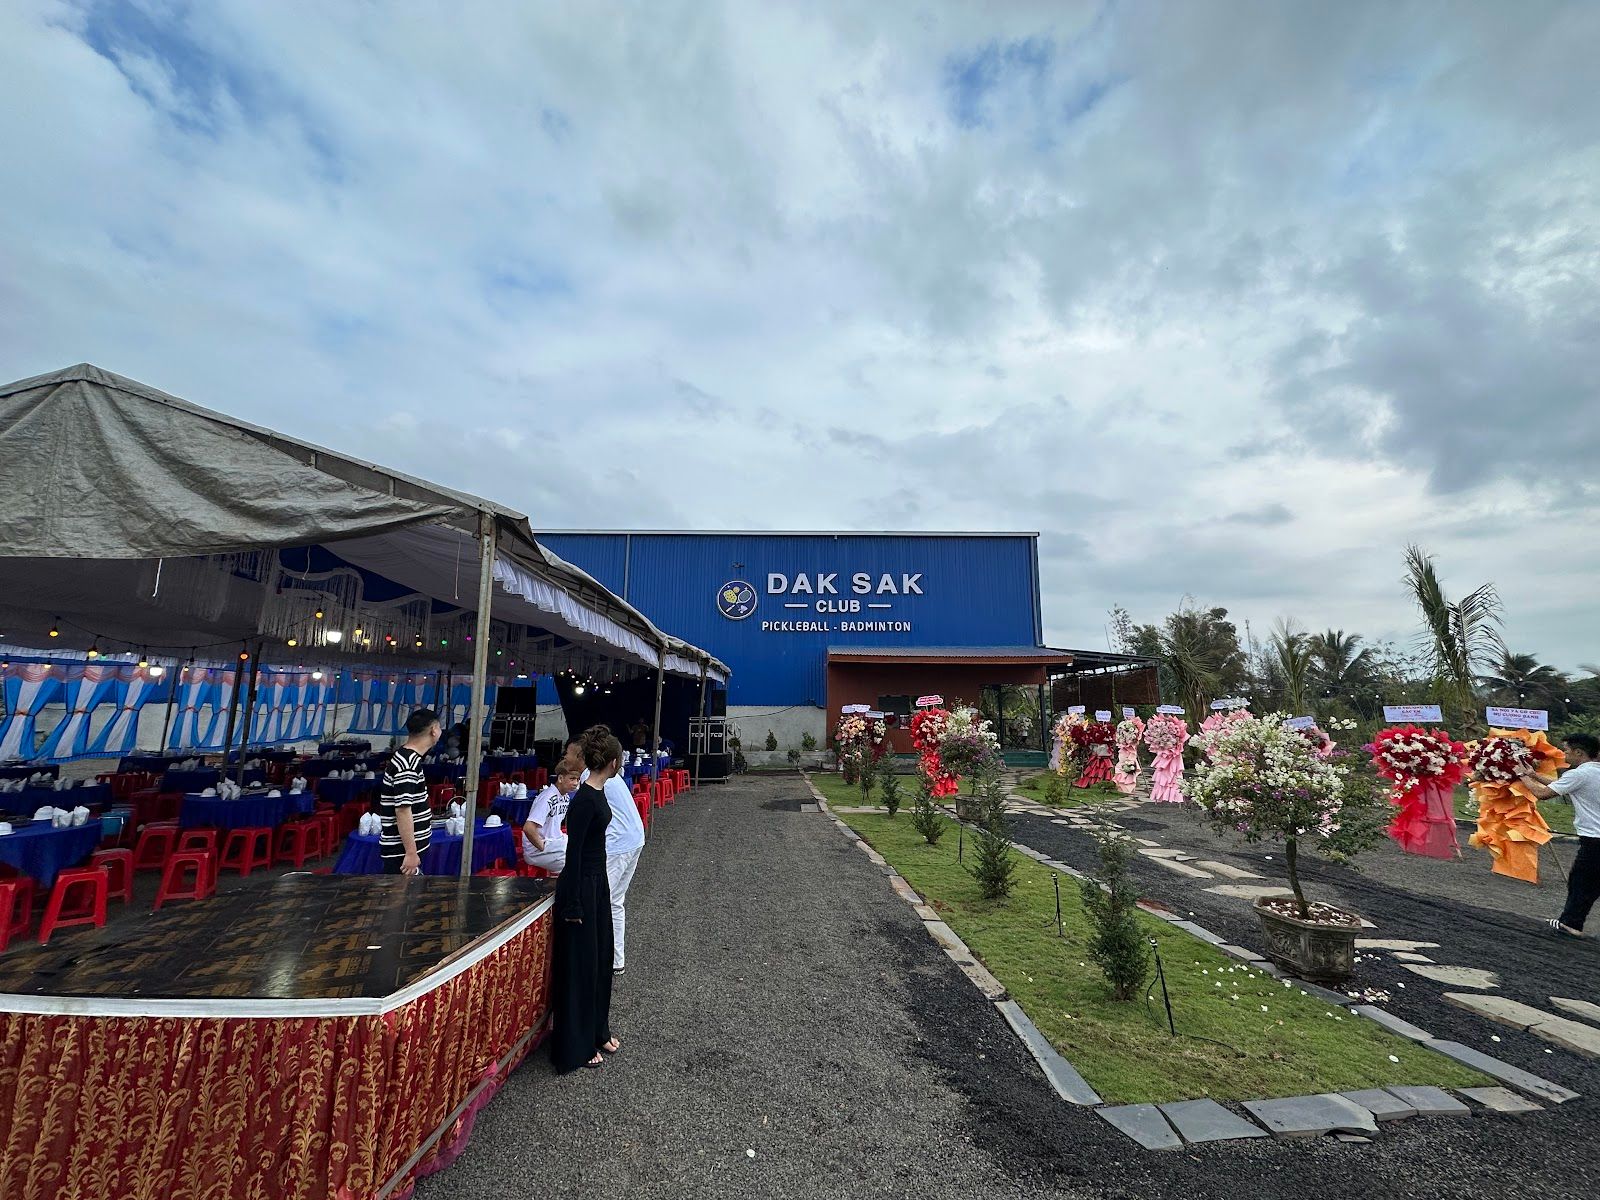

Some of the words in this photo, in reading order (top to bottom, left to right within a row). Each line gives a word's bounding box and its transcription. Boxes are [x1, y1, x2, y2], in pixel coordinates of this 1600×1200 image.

[767, 573, 838, 594] DAK
[852, 573, 923, 594] SAK
[815, 599, 861, 613] CLUB
[762, 621, 830, 631] PICKLEBALL
[841, 621, 911, 631] BADMINTON
